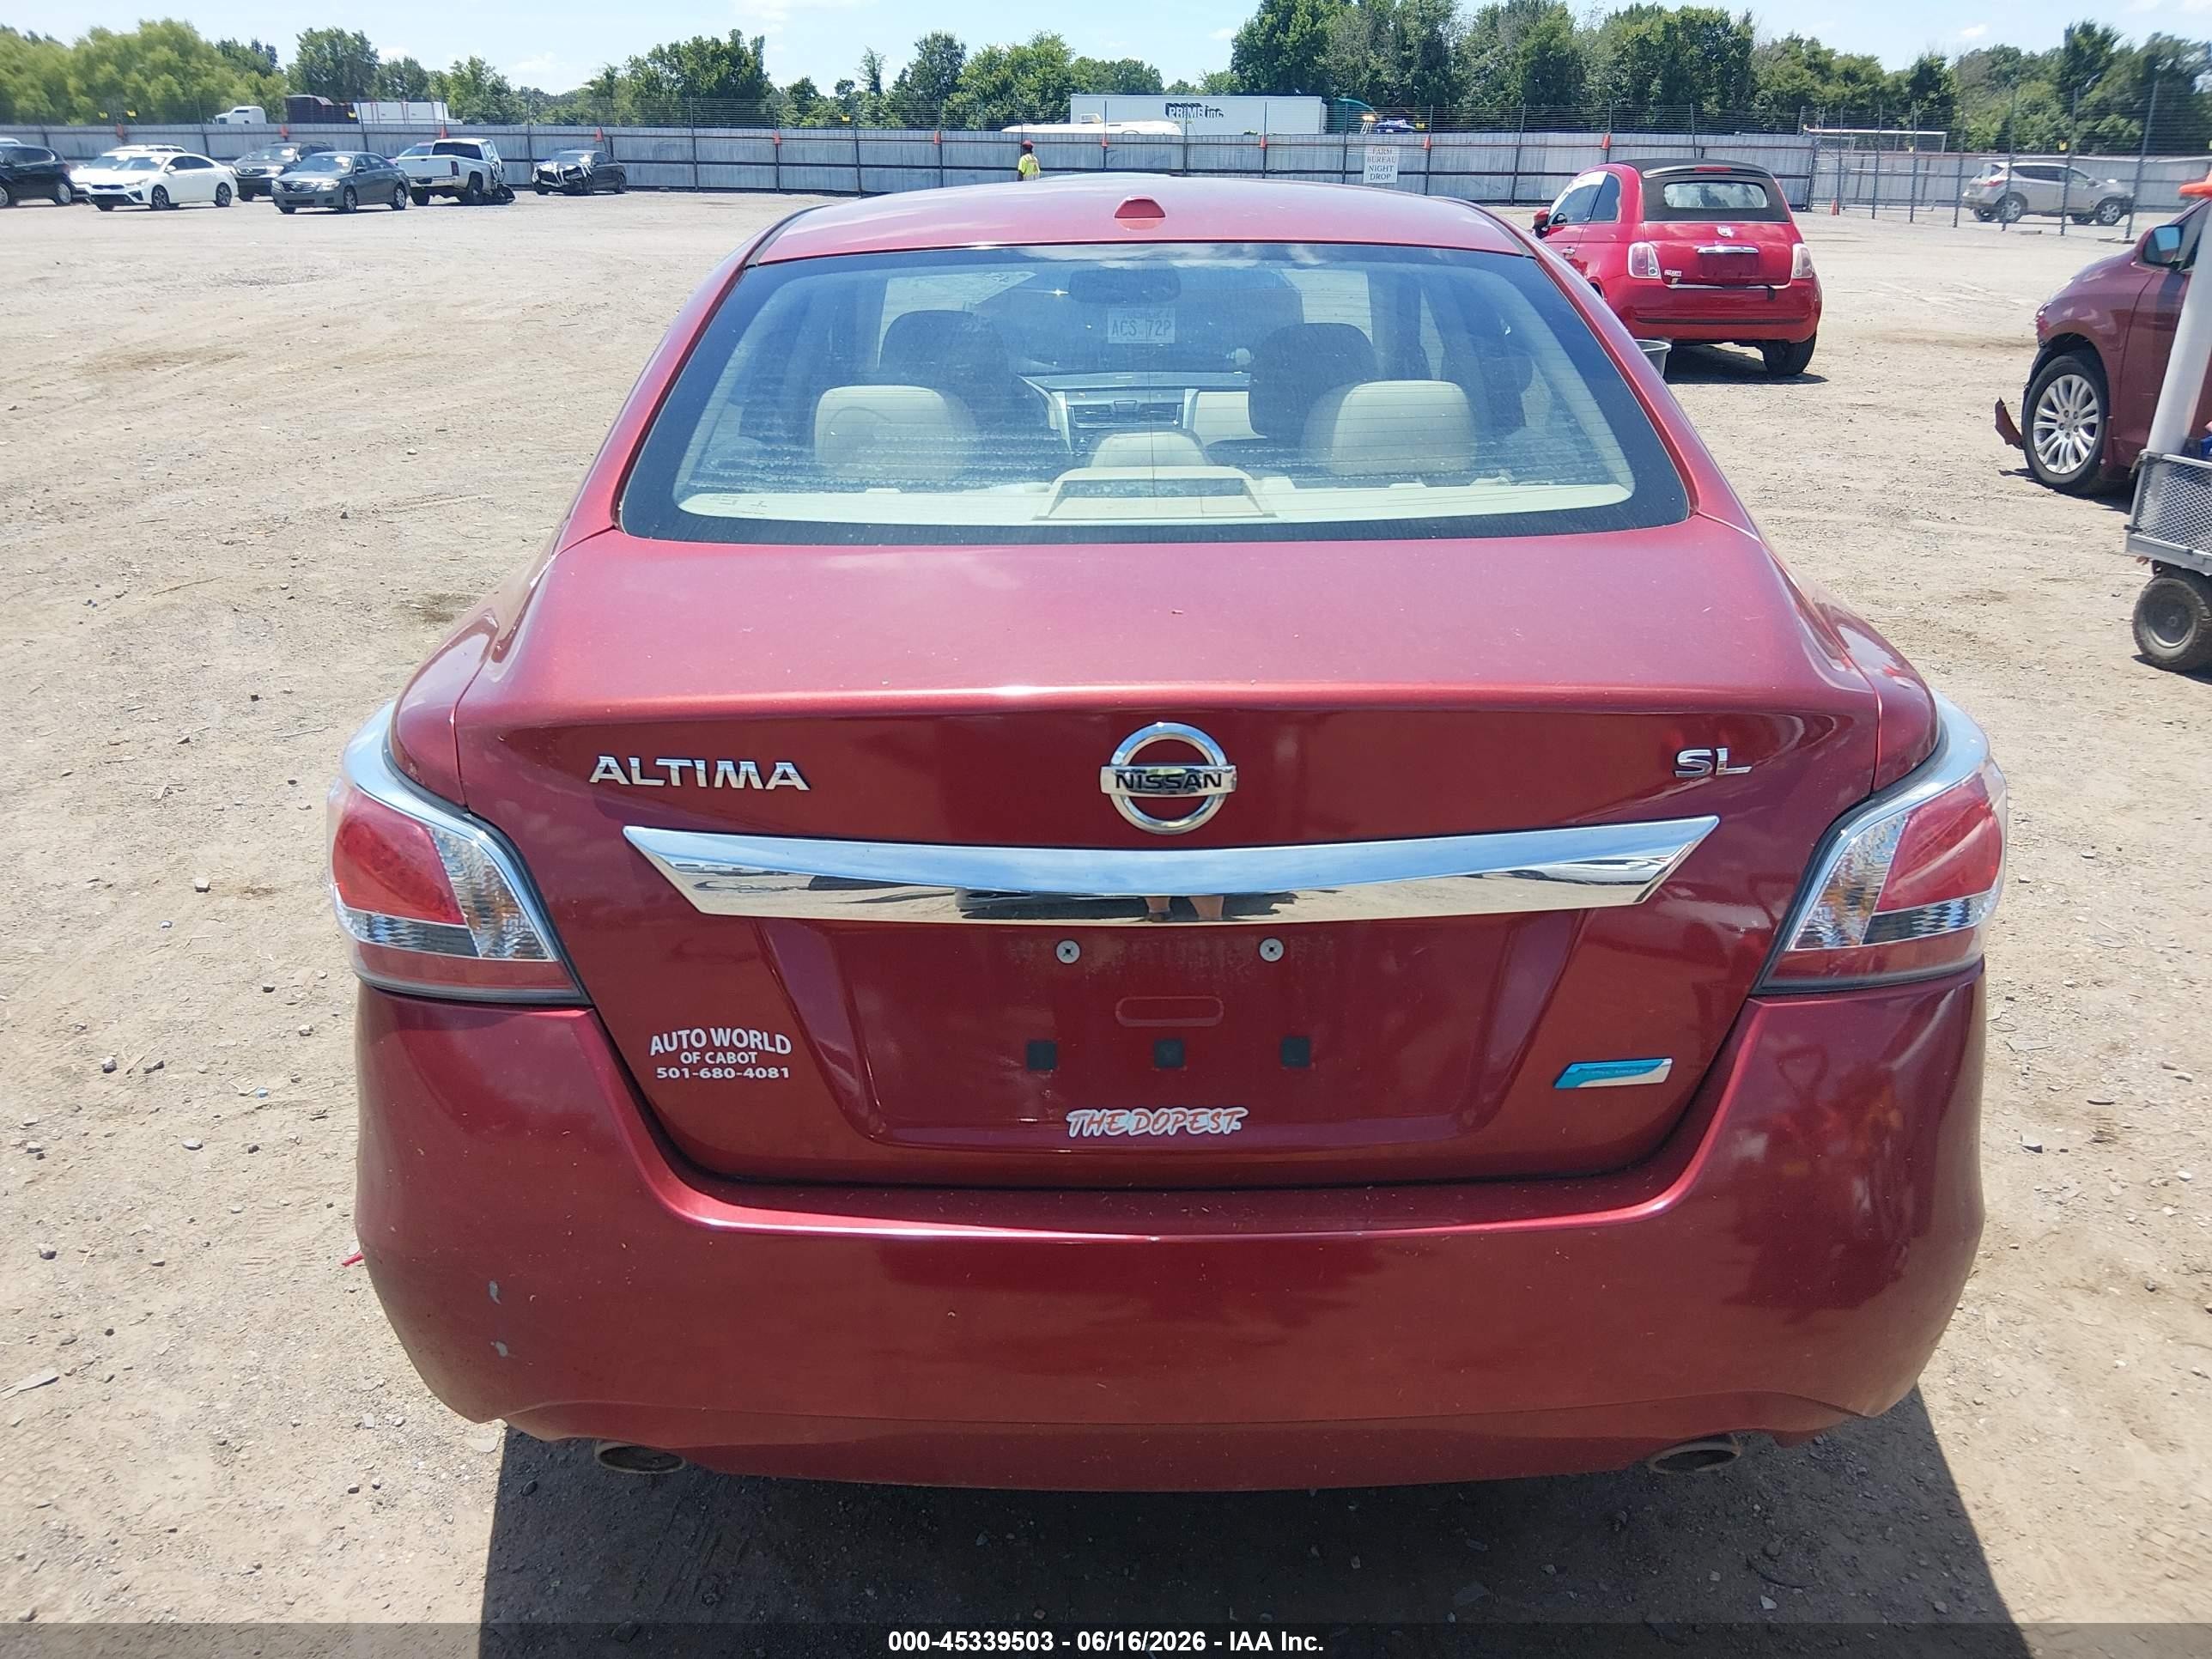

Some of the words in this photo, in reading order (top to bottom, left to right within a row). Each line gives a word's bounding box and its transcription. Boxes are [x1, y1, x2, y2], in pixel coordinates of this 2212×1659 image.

[1165, 103, 1203, 118] PRIME
[1372, 147, 1393, 155] FARM
[1112, 319, 1138, 337] ACS
[1675, 748, 1752, 777] SL
[589, 756, 810, 791] ALTIMA
[1116, 773, 1221, 789] NISSAN
[650, 1029, 707, 1056] AUTO
[709, 1028, 792, 1055] WORLD
[680, 1052, 701, 1065] OF
[704, 1052, 758, 1065] CABOT
[656, 1067, 790, 1079] 501-680-4081
[1066, 1109, 1129, 1137] THE
